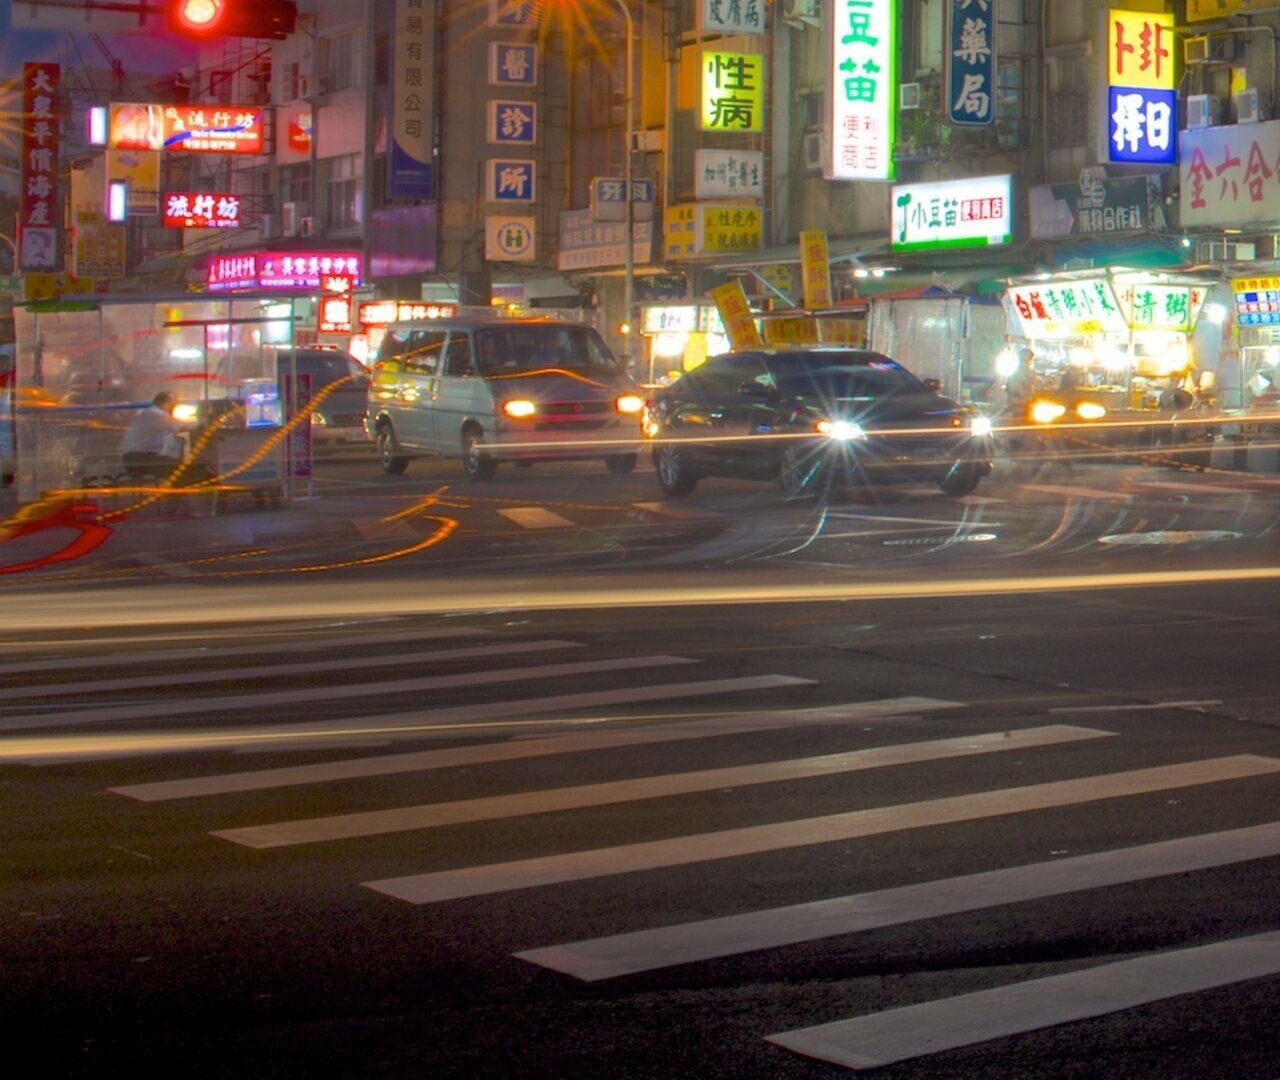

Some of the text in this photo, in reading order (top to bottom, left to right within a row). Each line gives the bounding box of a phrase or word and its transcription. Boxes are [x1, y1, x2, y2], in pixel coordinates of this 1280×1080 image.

[1115, 20, 1168, 79] 卜卦
[708, 56, 756, 129] 性病
[188, 109, 256, 129] 流行坊
[1111, 93, 1172, 153] 擇日
[166, 195, 240, 219] 流行坊
[602, 181, 648, 201] 牙科
